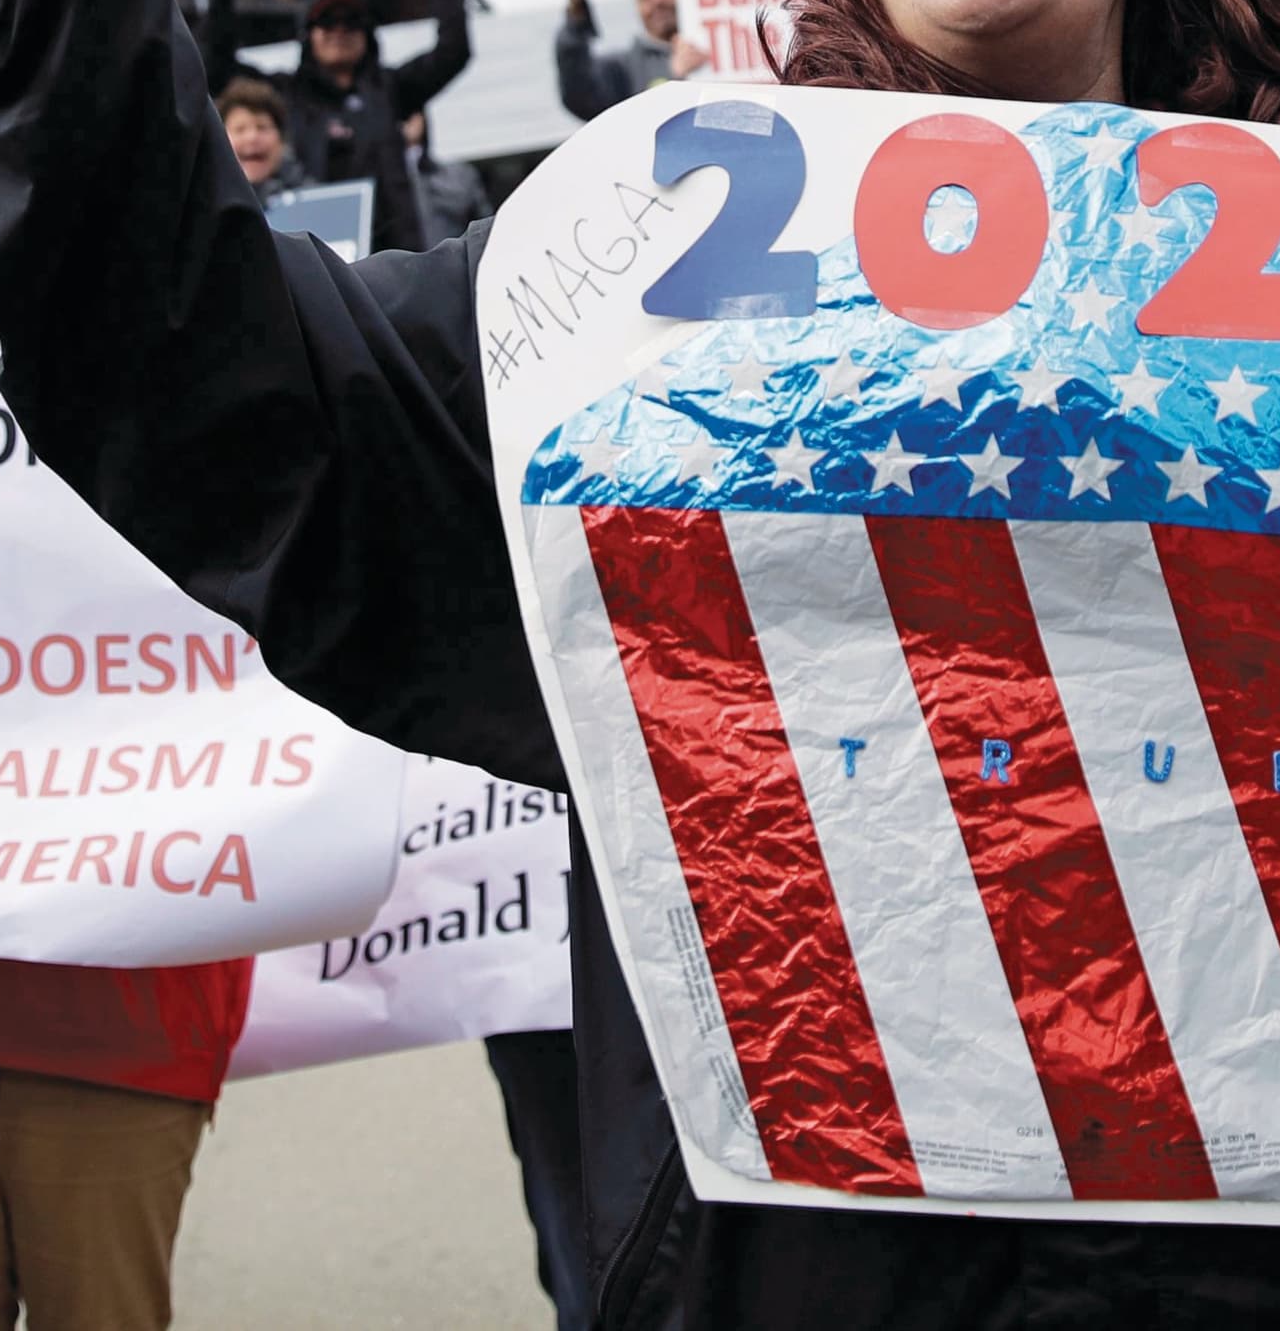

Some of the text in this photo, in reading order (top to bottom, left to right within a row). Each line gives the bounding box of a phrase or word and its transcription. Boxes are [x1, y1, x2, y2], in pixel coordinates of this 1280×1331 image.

[487, 181, 674, 390] #MAGA
[249, 733, 315, 789] IS
[320, 870, 531, 982] Donald
